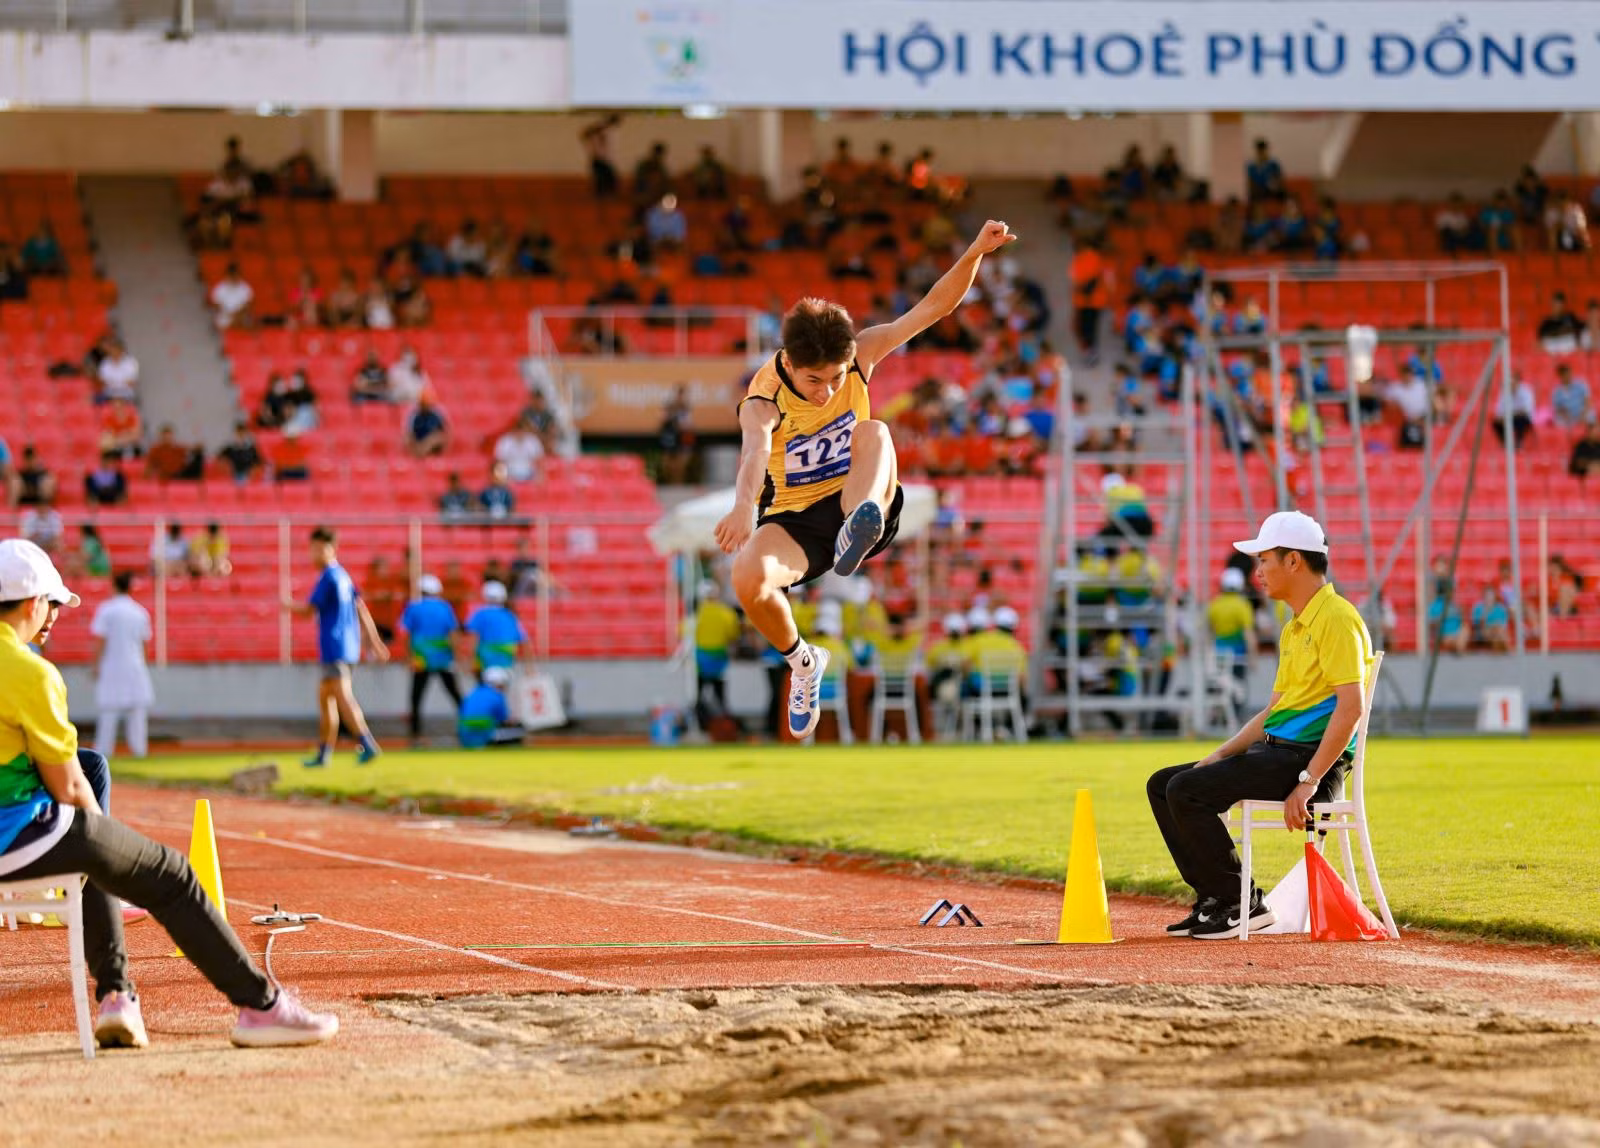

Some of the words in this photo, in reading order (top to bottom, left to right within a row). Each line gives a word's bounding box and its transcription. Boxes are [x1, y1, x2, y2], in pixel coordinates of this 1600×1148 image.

[842, 19, 968, 88] HỘI
[992, 21, 1185, 77] KHOẺ
[1206, 19, 1346, 77] PHÙ
[1370, 13, 1577, 78] ĐỔNG
[794, 428, 852, 467] 122
